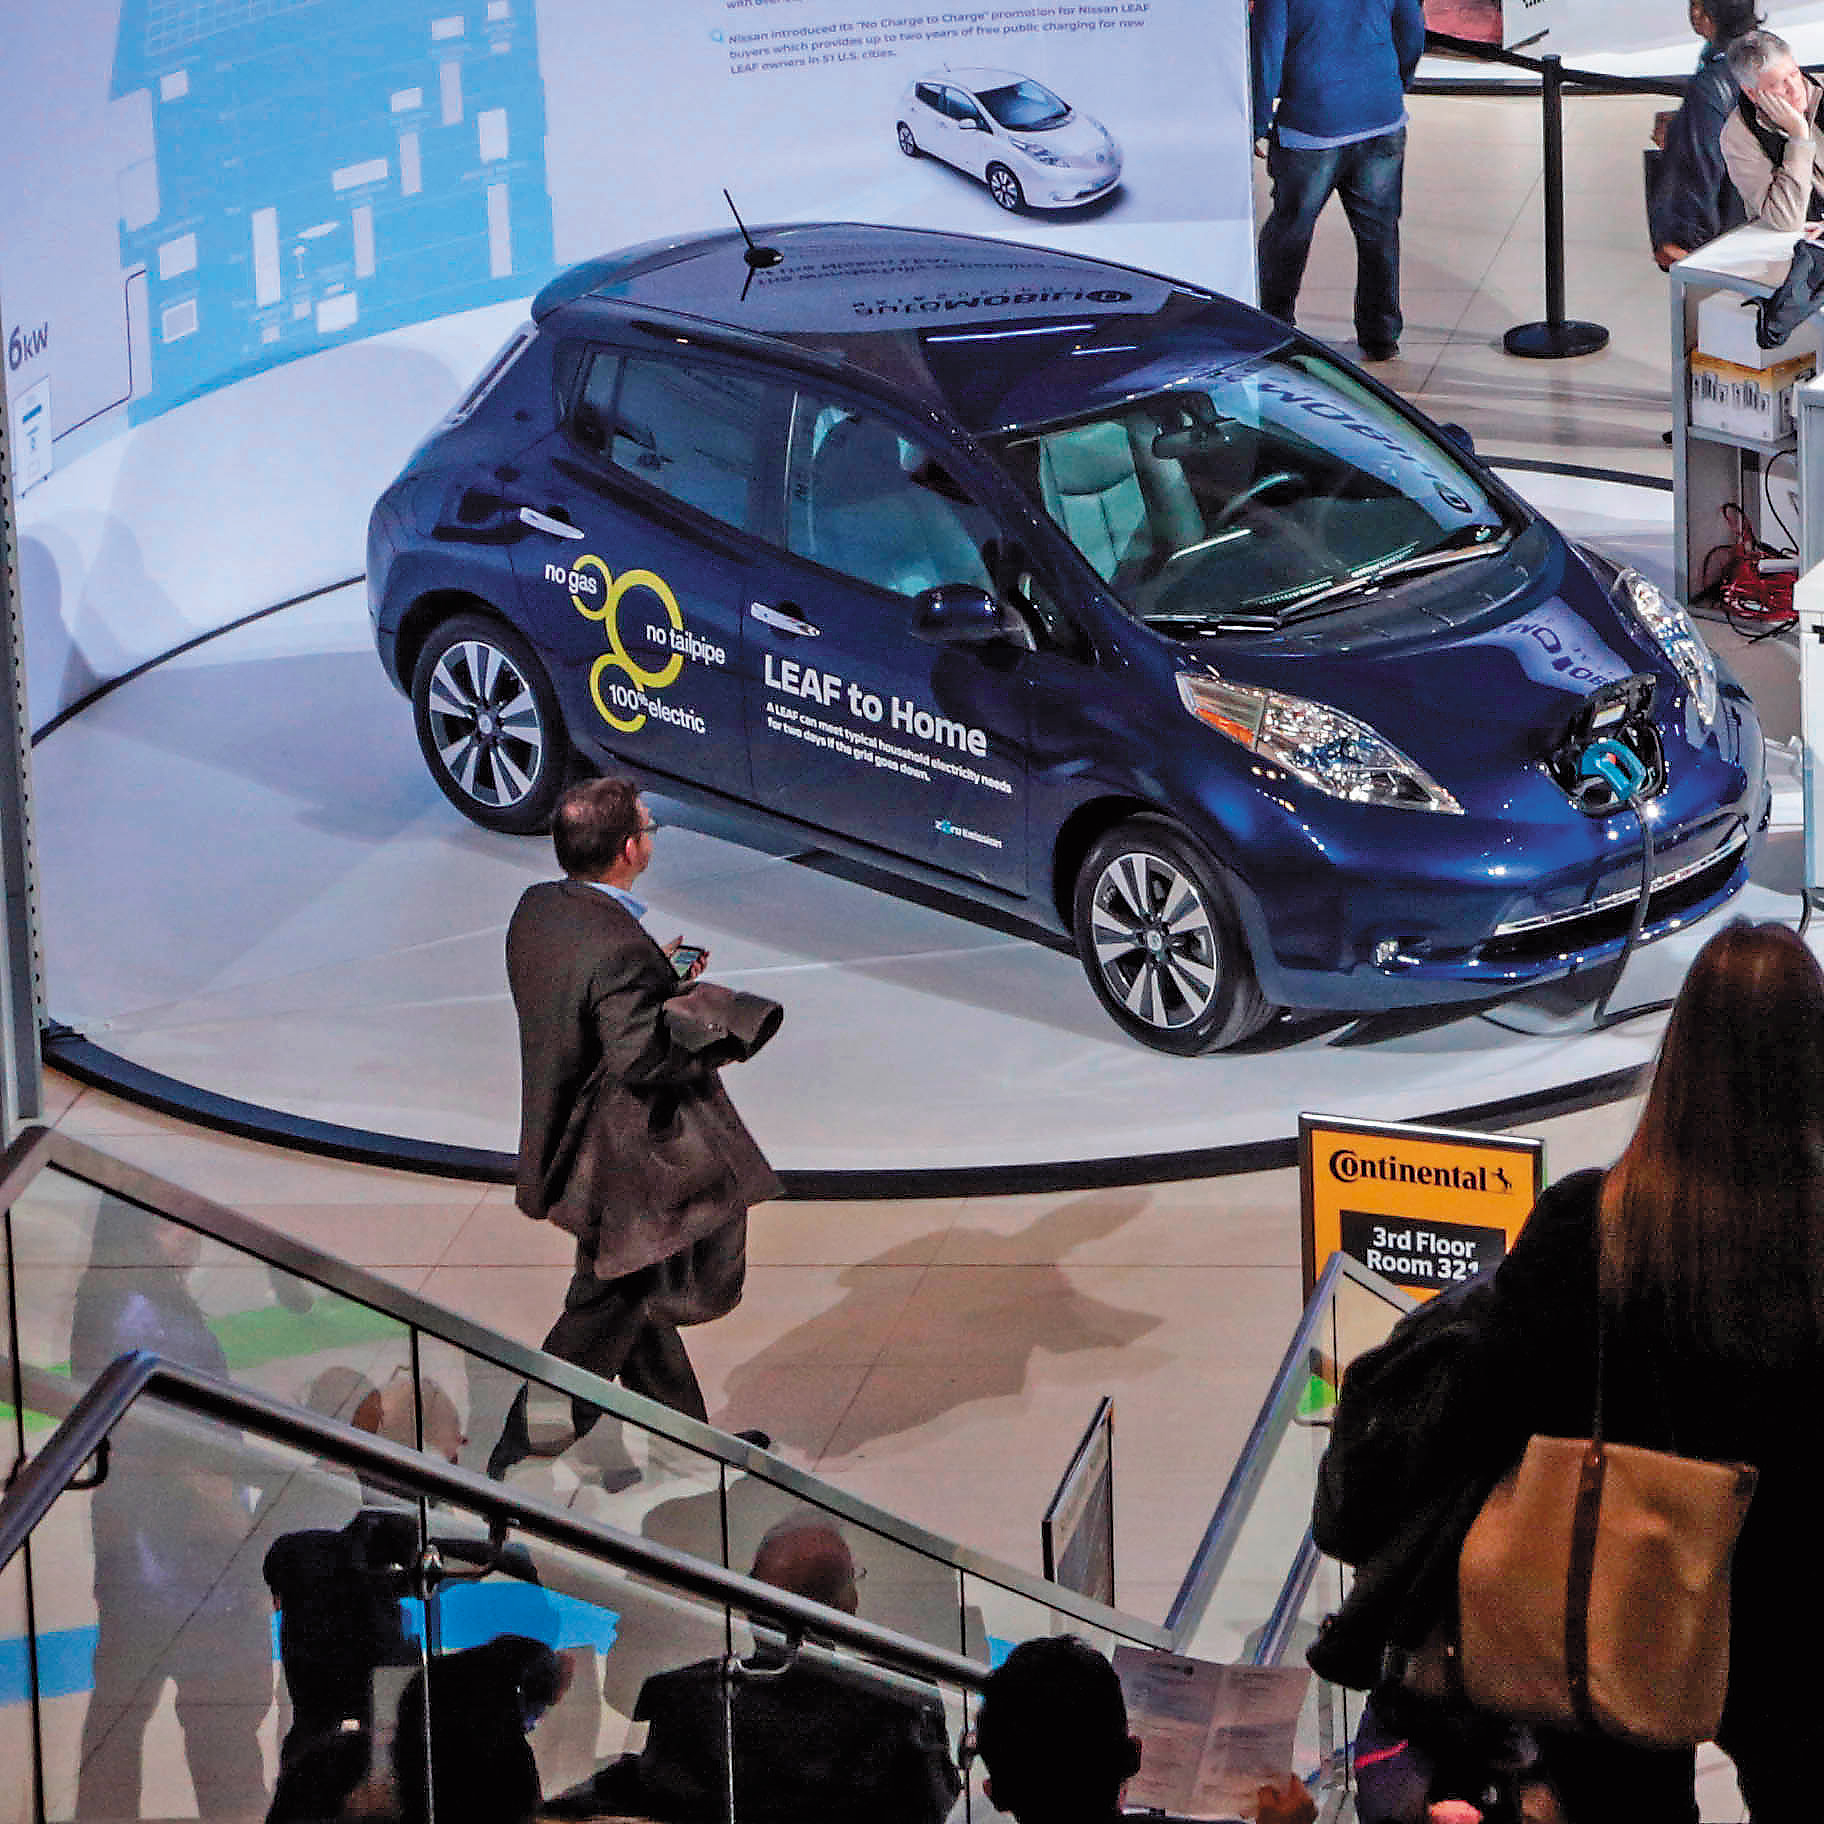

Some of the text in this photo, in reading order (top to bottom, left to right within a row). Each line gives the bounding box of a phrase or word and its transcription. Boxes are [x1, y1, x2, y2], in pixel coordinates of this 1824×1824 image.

[545, 563, 597, 595] no gas
[646, 624, 726, 665] no tailpipe
[649, 697, 706, 734] electric
[764, 654, 987, 758] LEAF to Home
[775, 704, 799, 721] LEAF
[1329, 1149, 1487, 1191] Continental
[1373, 1227, 1476, 1258] 3rd Floor
[1367, 1249, 1432, 1277] Room
